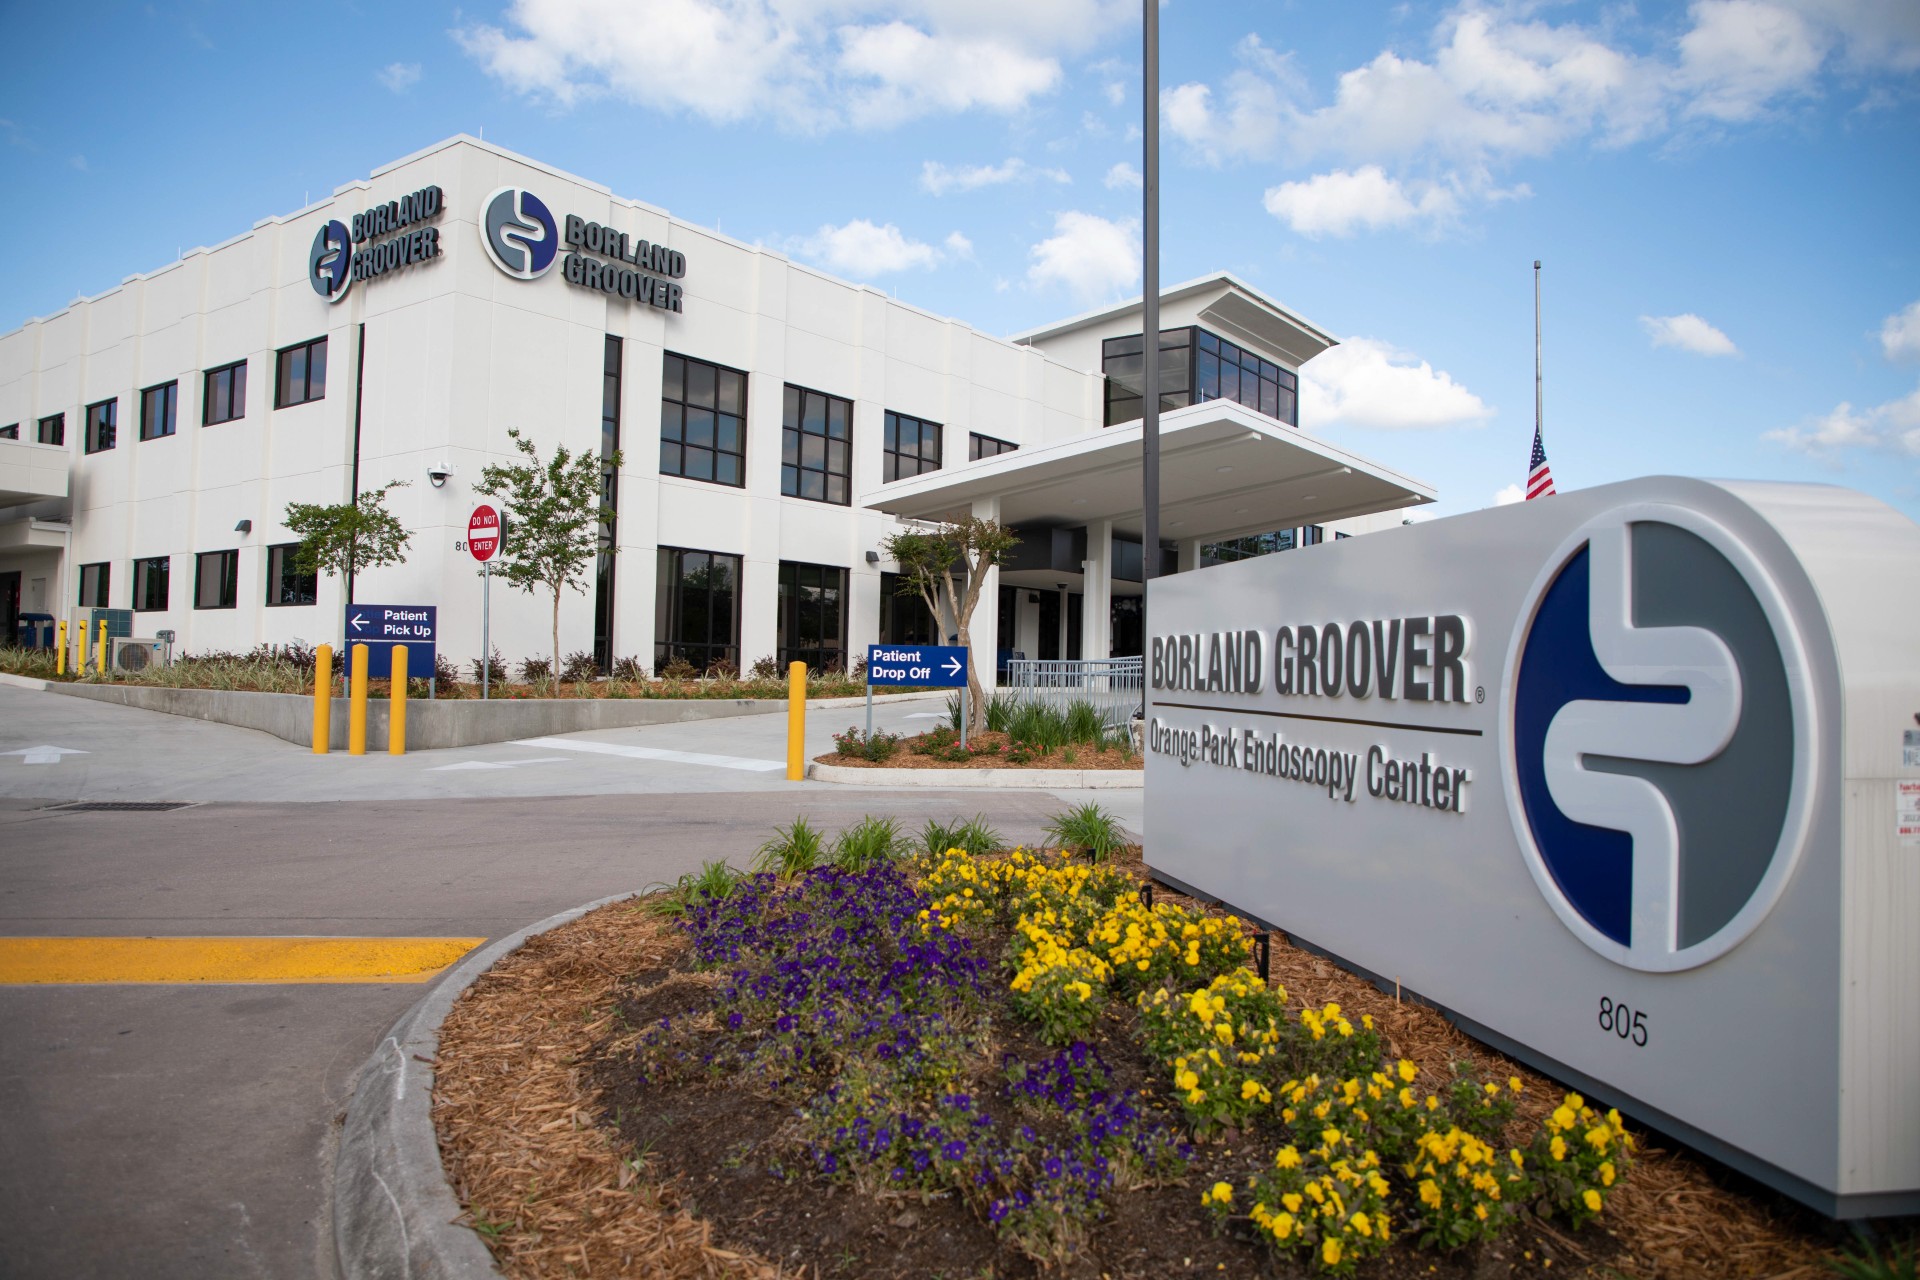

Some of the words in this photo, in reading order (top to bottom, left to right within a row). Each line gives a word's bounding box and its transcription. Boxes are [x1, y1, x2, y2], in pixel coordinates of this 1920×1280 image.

[352, 185, 442, 244] BORLAND
[351, 227, 439, 282] GROOVER
[565, 214, 686, 279] BORLAND
[564, 253, 683, 314] GROOVER
[472, 516, 481, 526] DO
[484, 515, 496, 525] NOT
[474, 541, 493, 551] ENTER
[383, 624, 411, 636] Pick
[414, 625, 432, 638] Up
[384, 609, 428, 622] Patient
[872, 666, 906, 681] Drop
[909, 666, 931, 680] Off
[873, 649, 922, 662] Patient
[1152, 630, 1266, 694] BORLAND
[1150, 717, 1200, 767] Orange
[1202, 724, 1242, 769] Park
[1244, 728, 1362, 803] Endoscopy
[1367, 743, 1473, 813] Center
[1598, 996, 1648, 1048] 805
